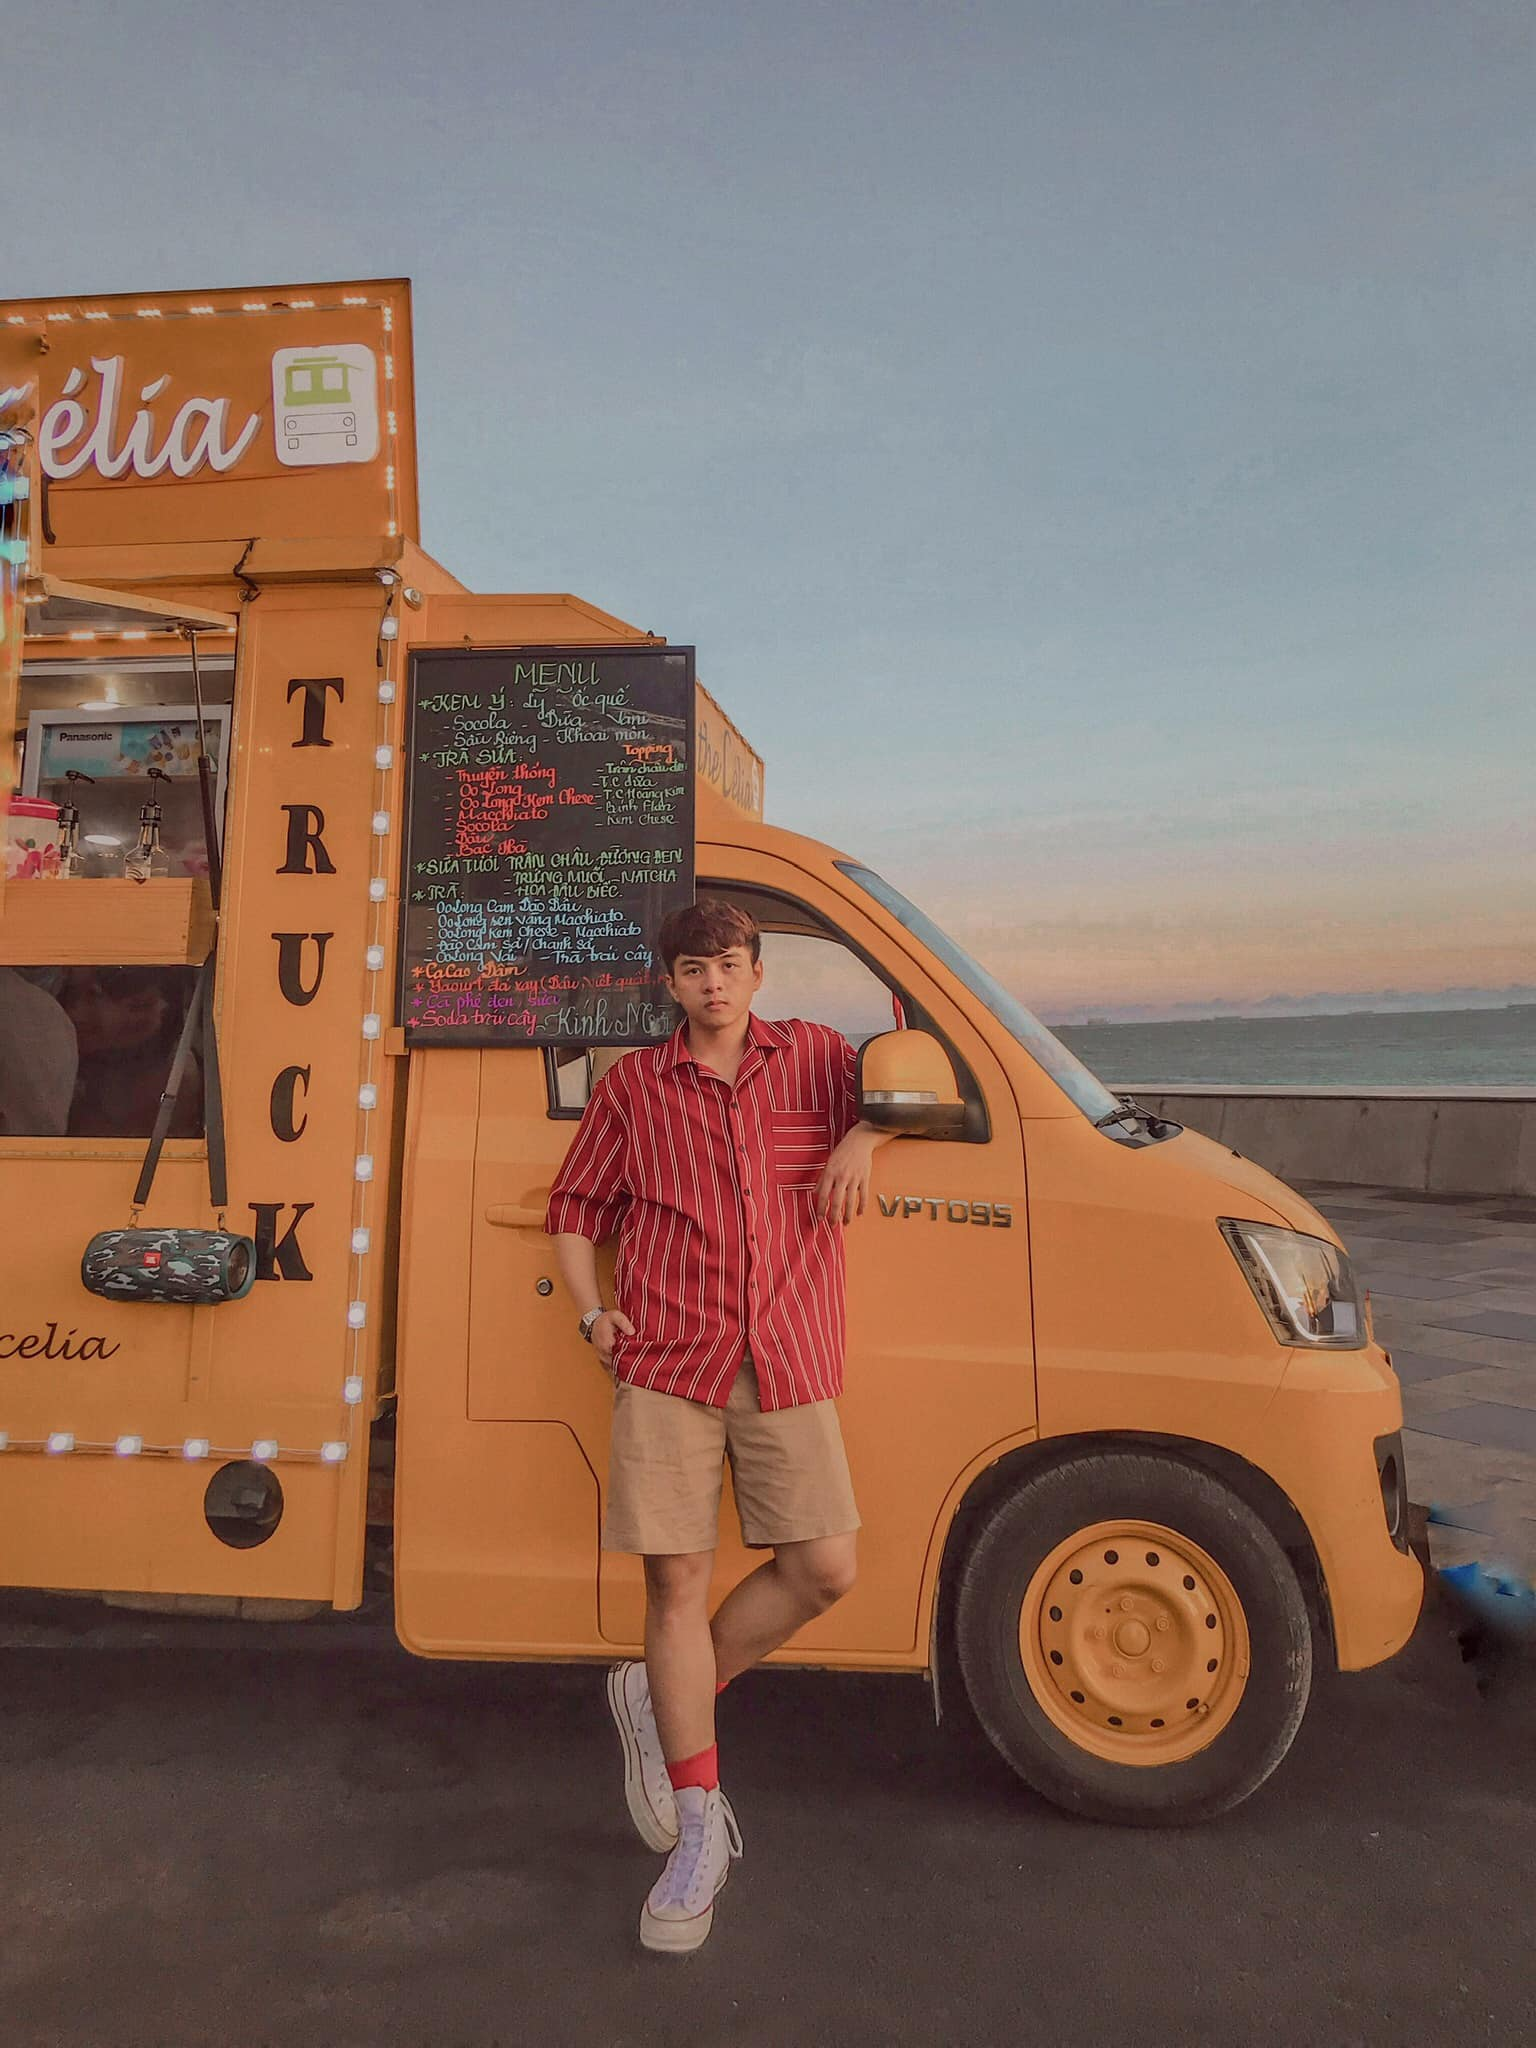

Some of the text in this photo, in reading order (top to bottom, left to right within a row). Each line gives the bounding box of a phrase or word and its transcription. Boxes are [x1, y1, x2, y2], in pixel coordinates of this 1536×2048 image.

[514, 662, 600, 686] MENU
[432, 693, 482, 713] KEM
[452, 711, 513, 732] Socola
[59, 731, 113, 742] Panasonic
[556, 727, 609, 744] Khoai
[622, 743, 674, 764] Topping
[514, 884, 547, 897] HOA
[487, 899, 515, 913] Cam
[247, 676, 345, 1282] TRUCK
[420, 1009, 469, 1027] Soda
[544, 998, 615, 1037] Kính
